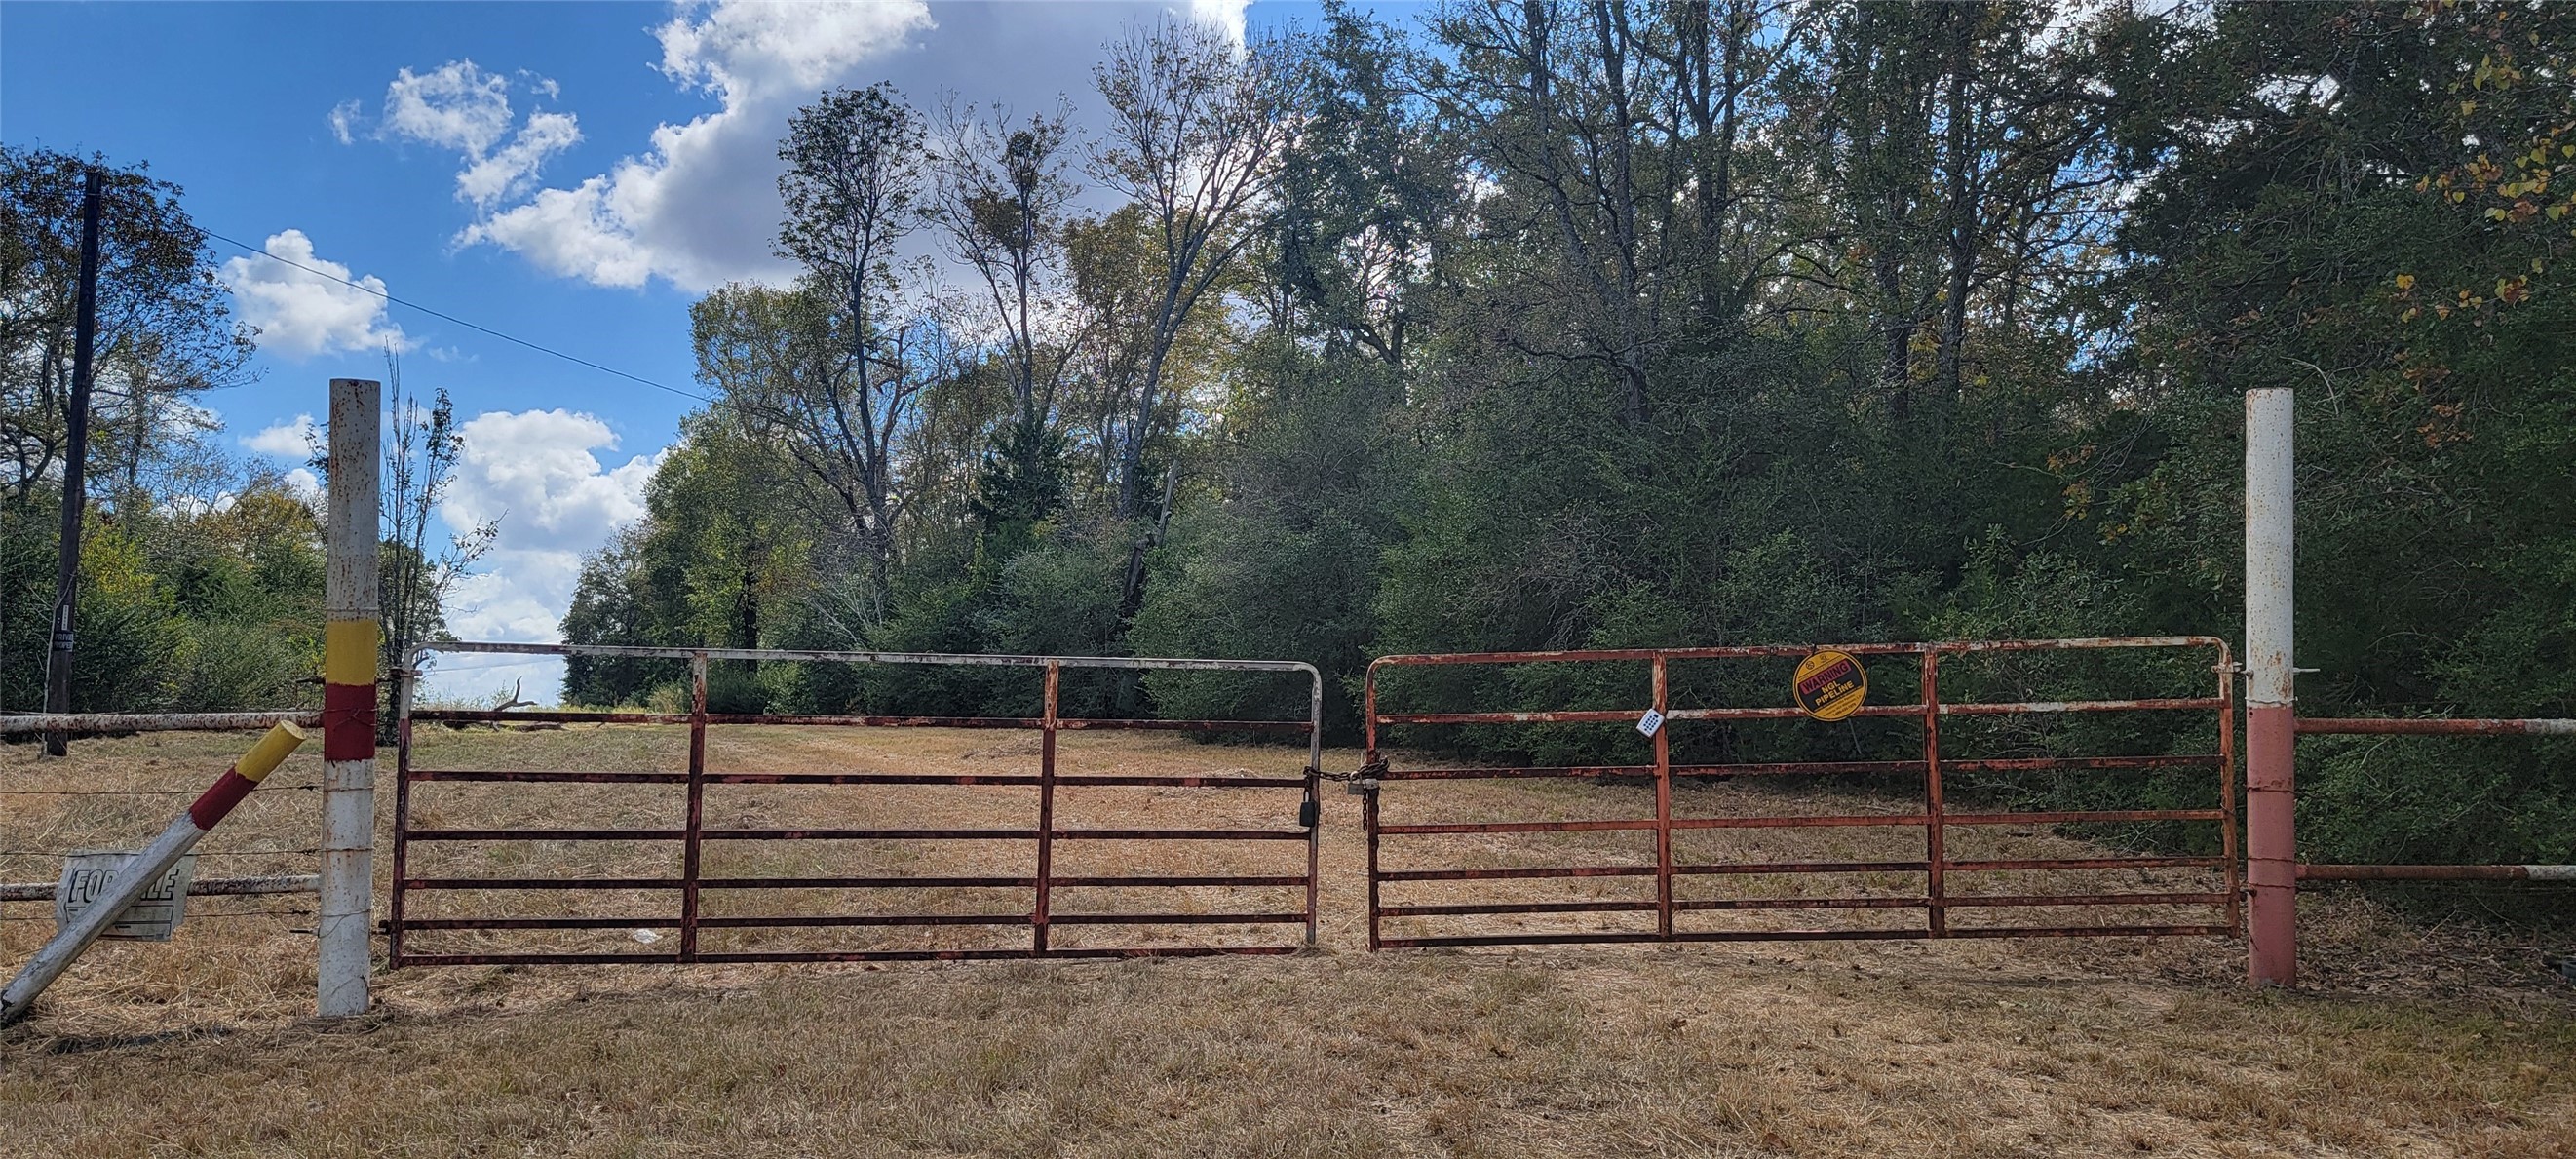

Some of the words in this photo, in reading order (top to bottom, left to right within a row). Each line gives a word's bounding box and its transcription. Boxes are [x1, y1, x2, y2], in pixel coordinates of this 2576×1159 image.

[1802, 662, 1849, 692] WARNING
[1821, 680, 1841, 694] NGL
[1815, 680, 1855, 706] PIPELINE
